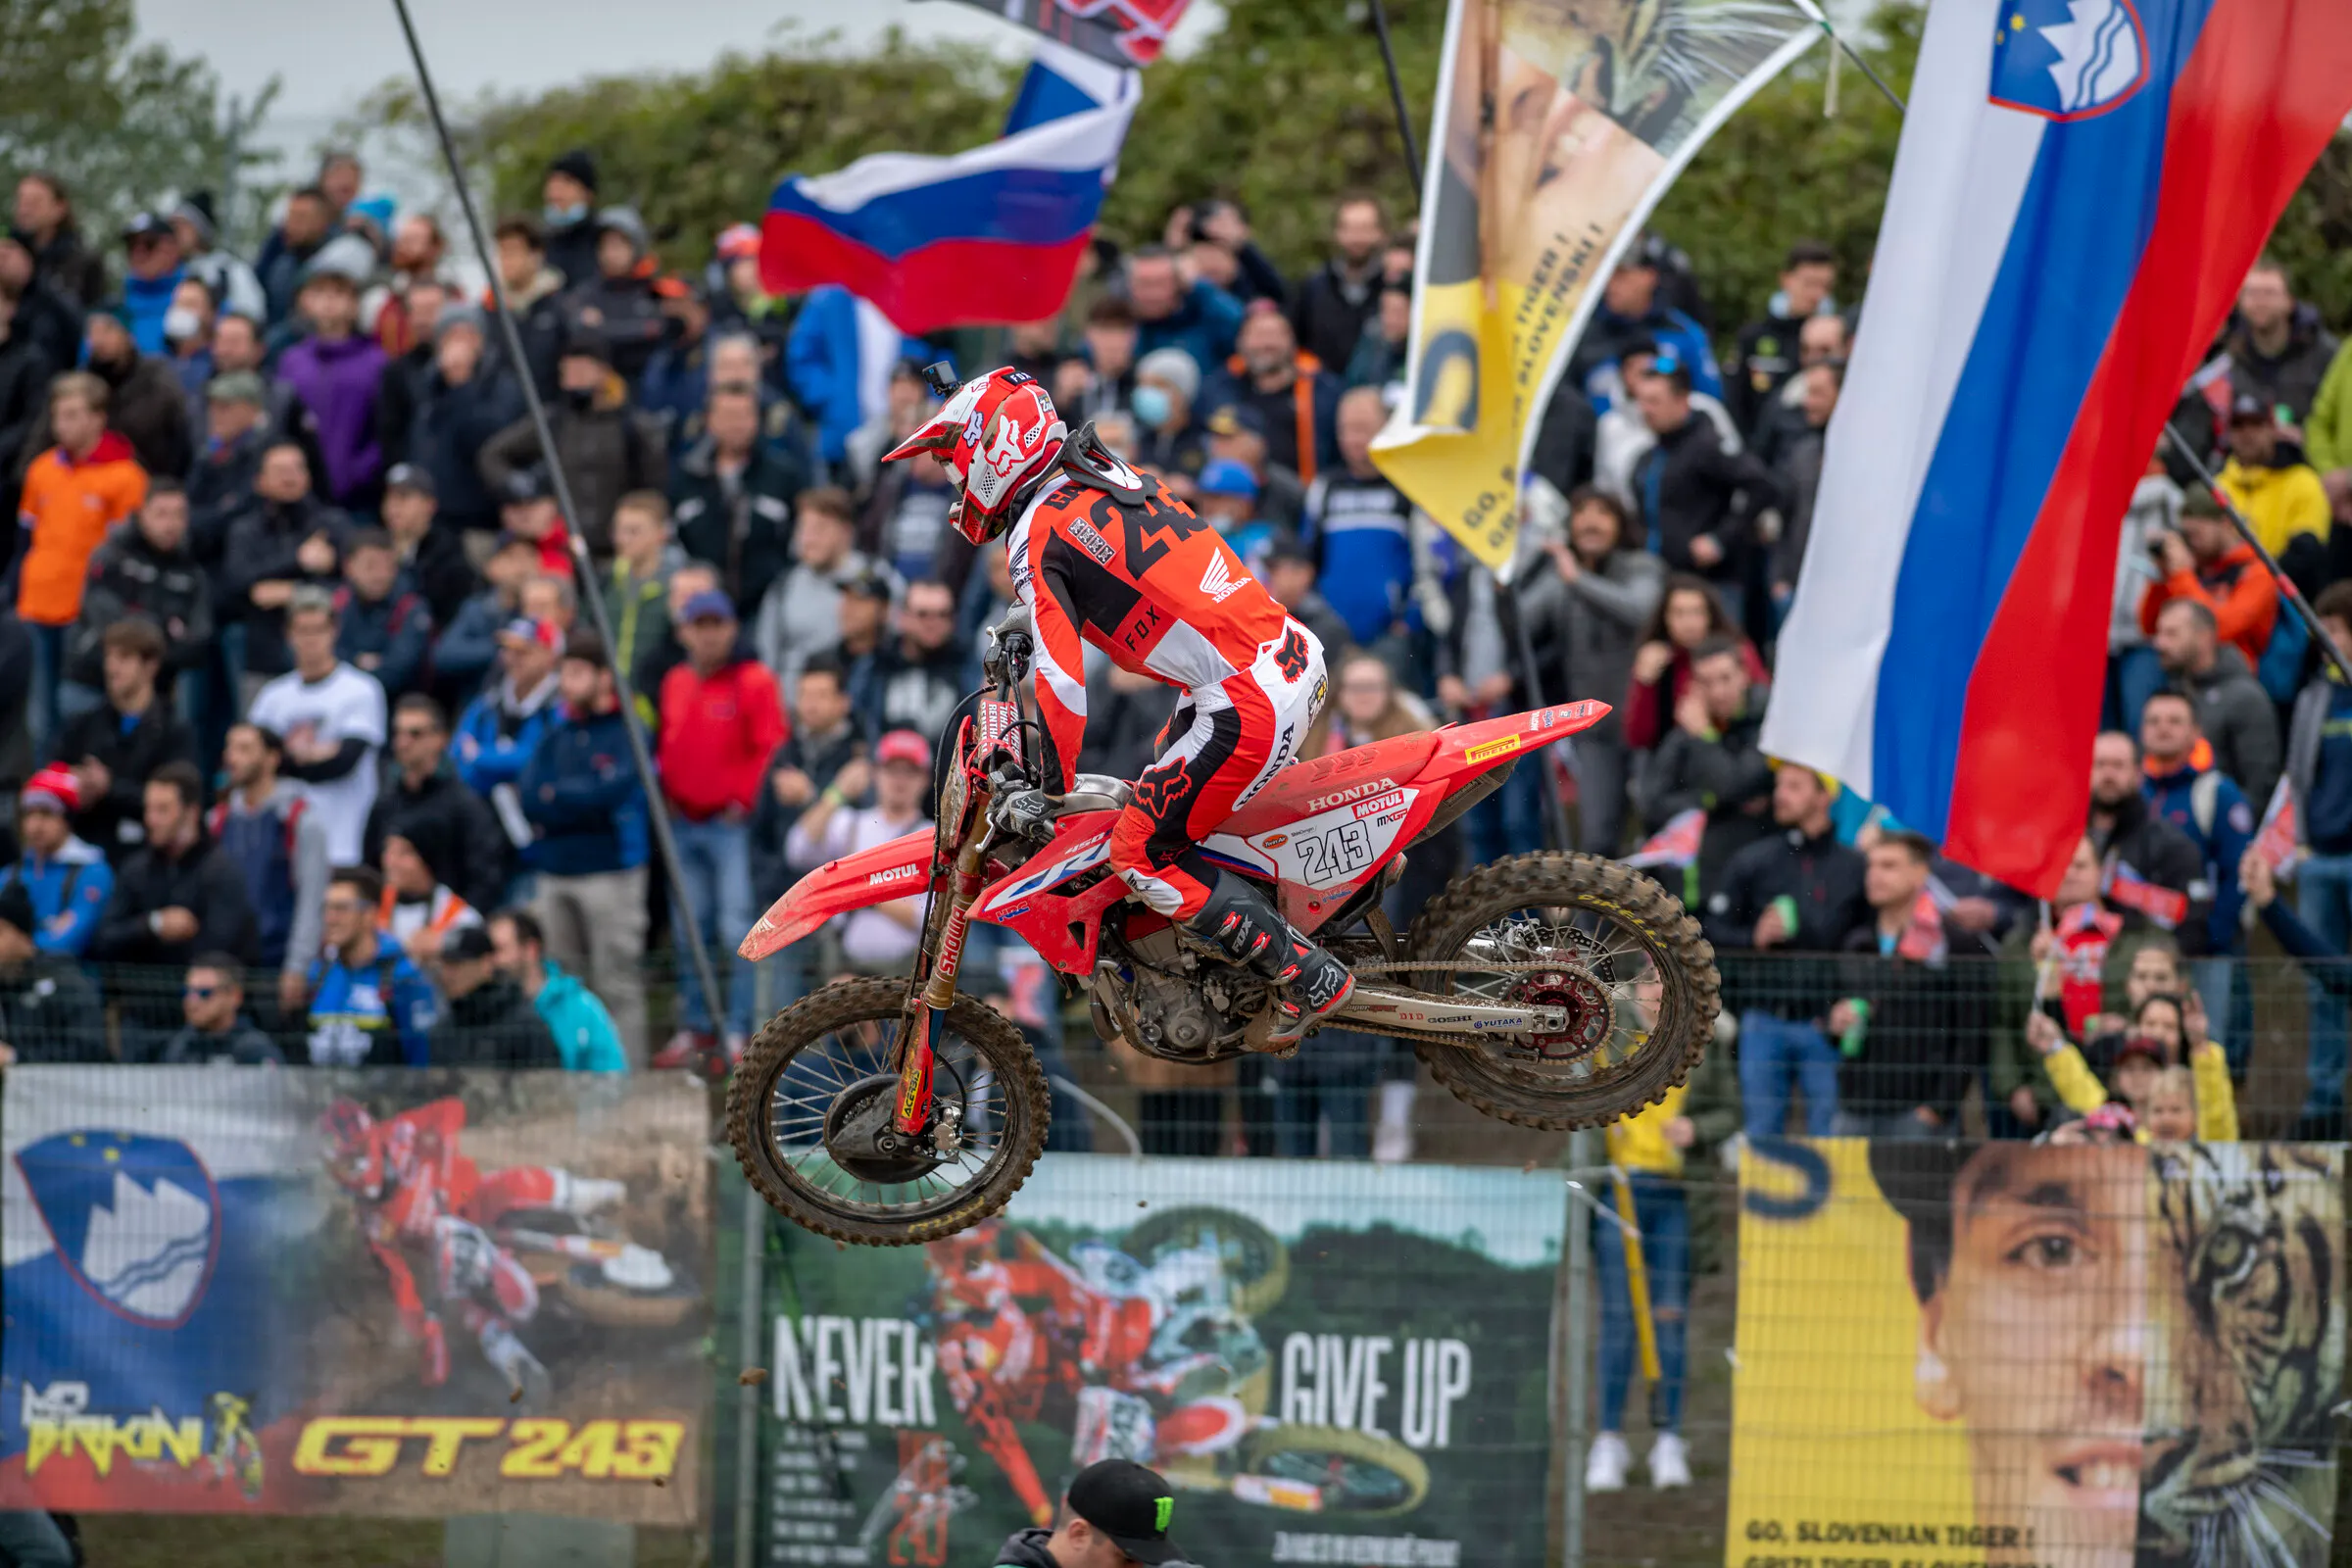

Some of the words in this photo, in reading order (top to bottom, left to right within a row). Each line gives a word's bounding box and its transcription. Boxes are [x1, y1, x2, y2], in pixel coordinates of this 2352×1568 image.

[1009, 371, 1032, 383] FOX
[1211, 576, 1252, 604] HONDA
[1124, 605, 1161, 652] FOX
[1237, 721, 1296, 808] HONDA
[1307, 777, 1399, 812] HONDA
[1355, 792, 1403, 818] MOTUL
[1295, 818, 1374, 886] 243
[869, 862, 919, 885] MOTUL
[995, 901, 1030, 922] HRC
[938, 905, 968, 977] SHOWA
[1231, 912, 1253, 954] FOX
[1428, 1015, 1473, 1024] GOSHI
[1483, 1017, 1523, 1027] YUTAKA
[774, 1313, 937, 1427] NEVER
[1281, 1331, 1394, 1441] GIVE
[1401, 1337, 1473, 1448] UP
[292, 1416, 505, 1477] GT
[500, 1418, 685, 1479] 243
[1745, 1519, 1789, 1546] GO,
[1797, 1520, 1939, 1546] SLOVENIAN
[1946, 1523, 2019, 1547] TIGER
